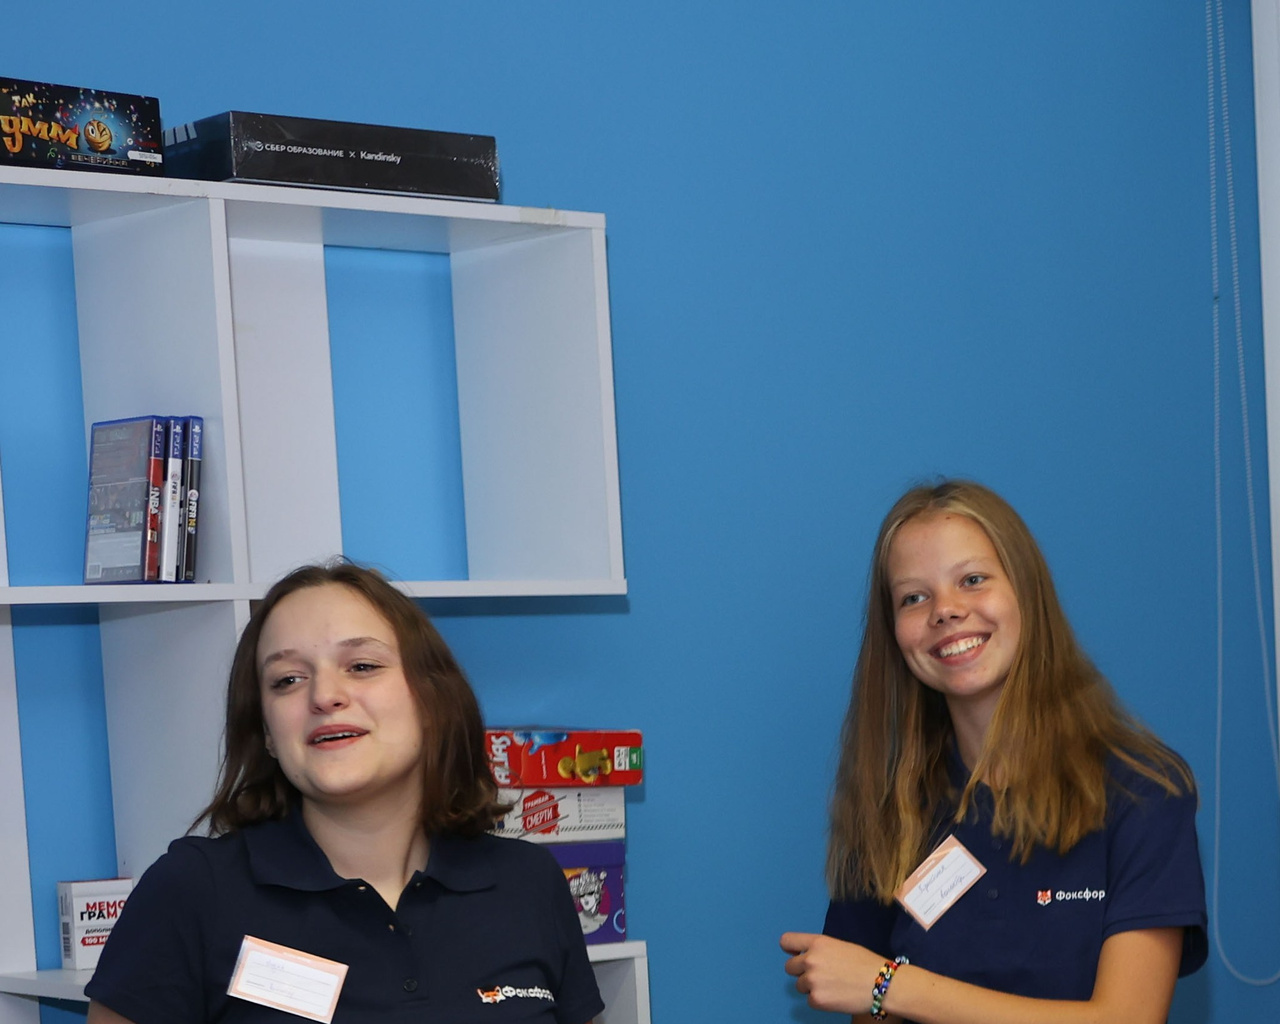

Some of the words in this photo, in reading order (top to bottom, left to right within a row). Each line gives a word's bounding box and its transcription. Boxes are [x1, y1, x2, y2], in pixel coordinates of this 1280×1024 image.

[265, 143, 286, 151] СБЕР
[287, 145, 344, 158] ОБРАЗОВАНИЕ
[360, 151, 401, 165] Kandinsky
[149, 490, 161, 514] NBA
[526, 808, 553, 829] СМЕРТИ
